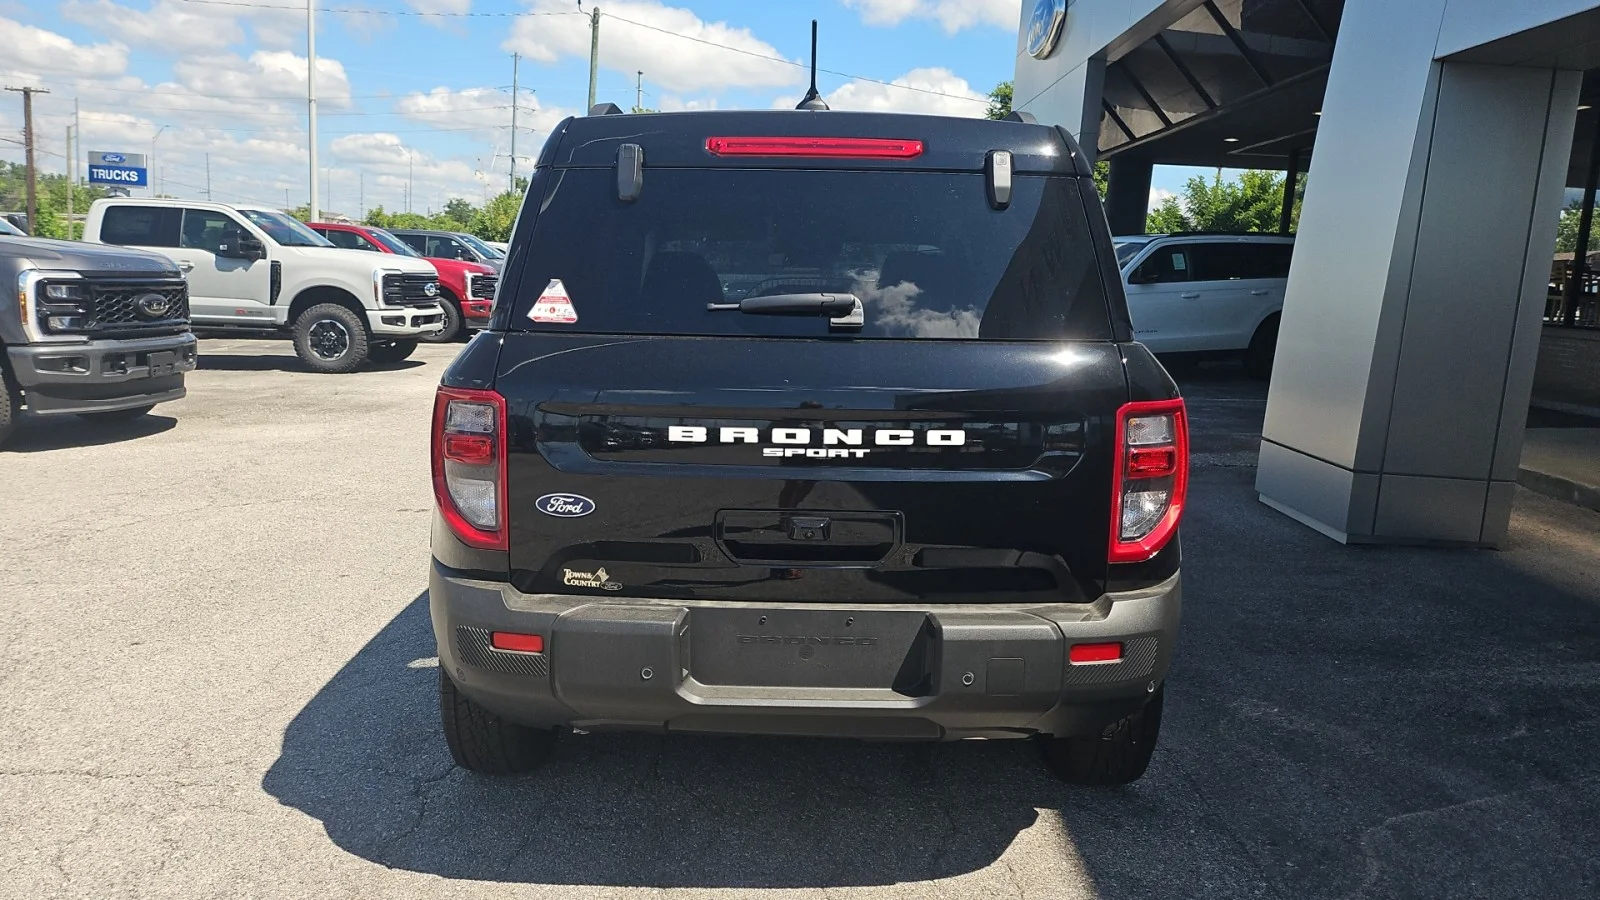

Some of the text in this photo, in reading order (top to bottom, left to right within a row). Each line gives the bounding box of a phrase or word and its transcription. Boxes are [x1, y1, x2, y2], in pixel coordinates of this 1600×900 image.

[92, 168, 139, 182] TRUCKS
[668, 425, 966, 446] BRONCO
[763, 448, 870, 458] SPORT
[546, 496, 584, 514] Ford
[563, 577, 601, 588] COUNTRY
[736, 634, 878, 646] BRONCO
